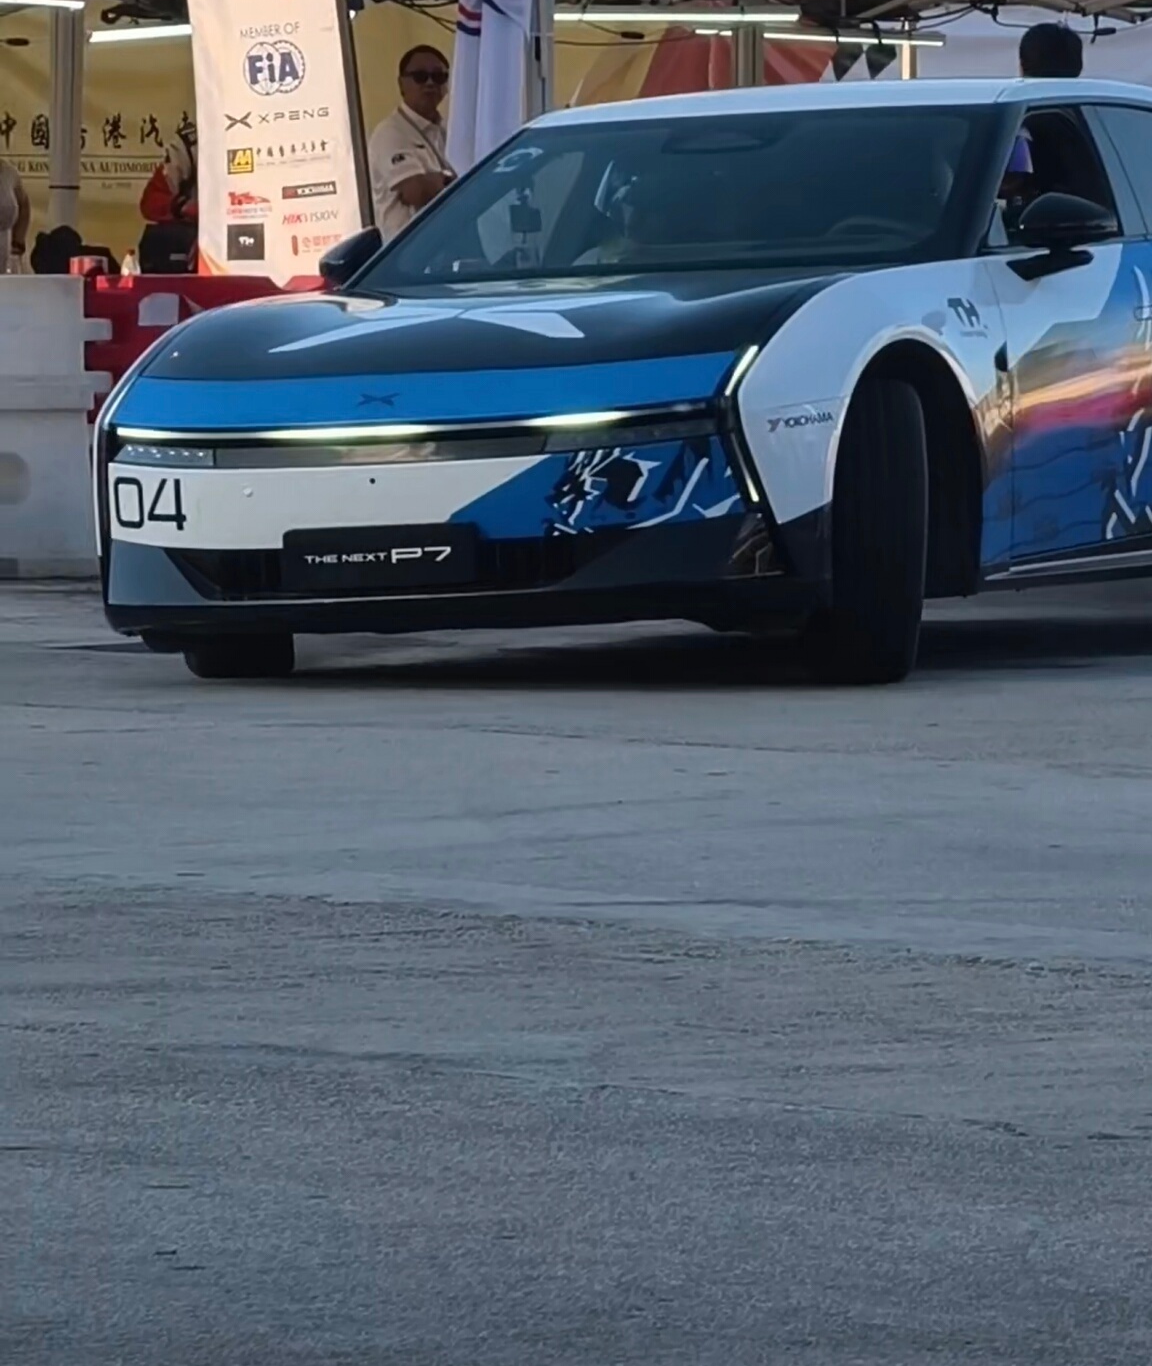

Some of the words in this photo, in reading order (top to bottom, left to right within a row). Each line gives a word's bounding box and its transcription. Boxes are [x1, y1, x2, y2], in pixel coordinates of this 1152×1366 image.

[239, 23, 282, 40] MEMBER
[283, 21, 301, 36] OF
[257, 106, 330, 125] XPENG
[0, 110, 196, 150] 中國港汽
[28, 161, 49, 173] KON
[99, 160, 155, 174] AUTOMOBI
[782, 411, 834, 429] YOKOHAMA
[114, 475, 188, 532] 04
[304, 553, 339, 565] THE
[341, 551, 388, 564] NEXT
[390, 545, 452, 565] P7
